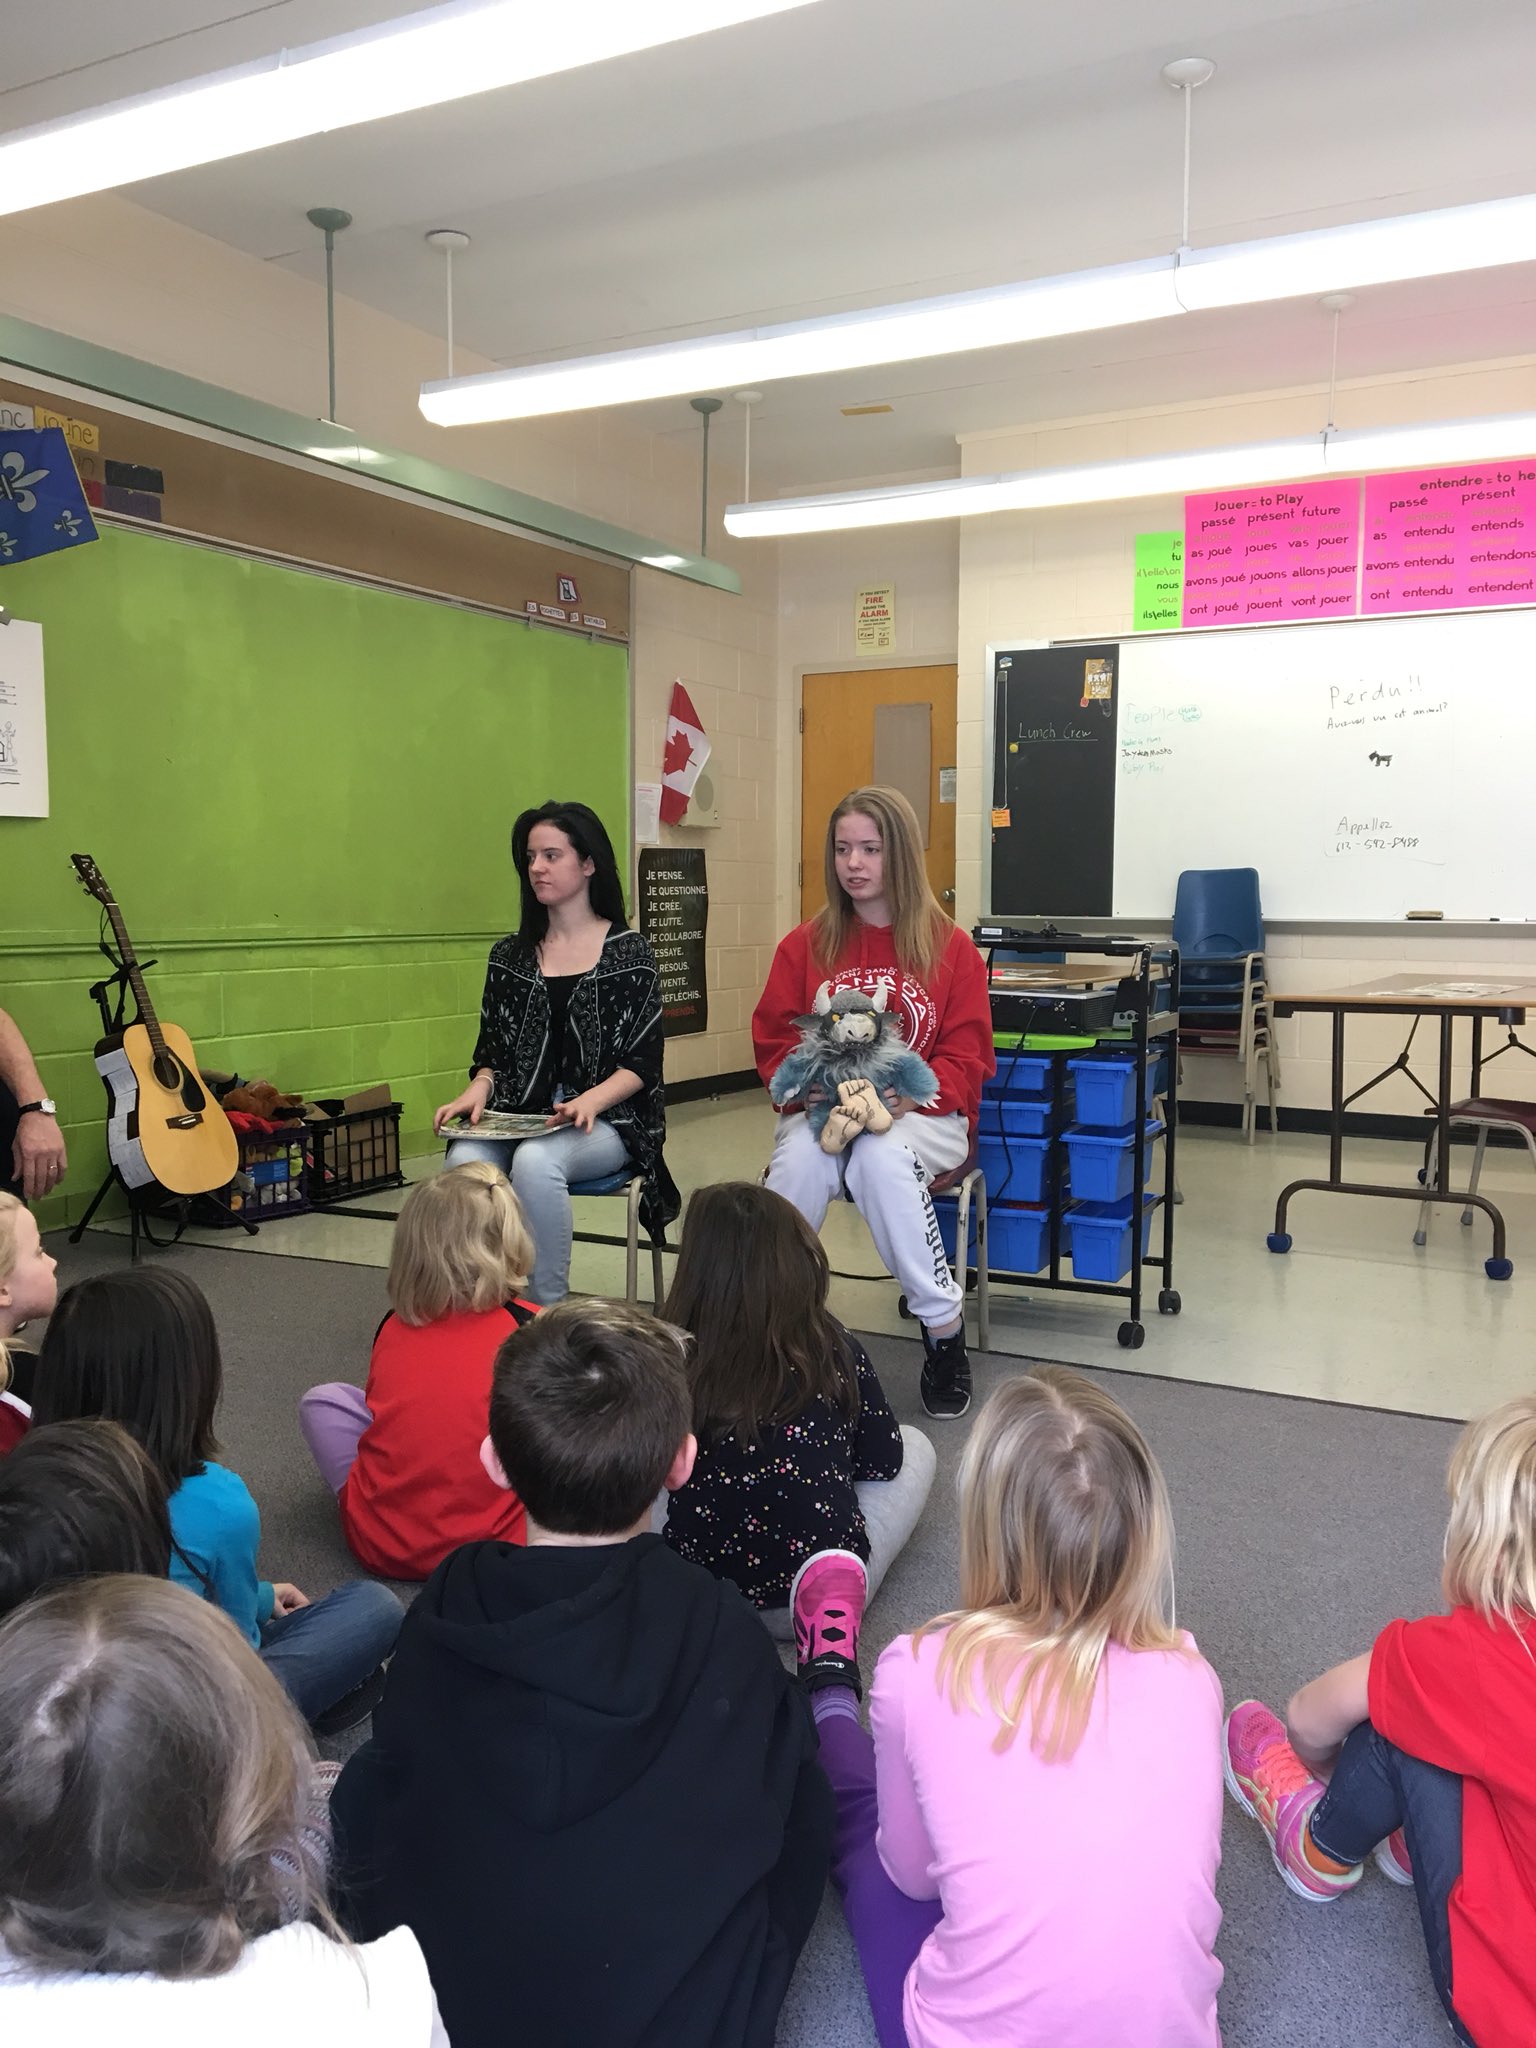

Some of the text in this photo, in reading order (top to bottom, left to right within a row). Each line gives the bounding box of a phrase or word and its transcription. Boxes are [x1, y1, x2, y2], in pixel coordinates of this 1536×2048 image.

[1419, 475, 1483, 491] entendre
[1497, 471, 1512, 483] to
[1260, 496, 1273, 507] to
[1276, 493, 1304, 507] Play
[1389, 486, 1516, 512] passé présent
[1201, 505, 1341, 532] passé présent future
[1373, 517, 1525, 541] as entendu entends
[1173, 539, 1183, 550] je
[1191, 535, 1349, 560] as joué joues vas jouer
[1171, 552, 1182, 561] tu
[1365, 559, 1401, 571] avons
[1403, 554, 1455, 568] entendu
[1470, 548, 1536, 563] entendons
[1185, 576, 1218, 587] avons
[1221, 573, 1246, 587] joué
[1250, 570, 1287, 585] jouons
[1292, 565, 1326, 578] allons
[1326, 564, 1358, 579] jouer
[1156, 581, 1180, 590] nous
[1370, 589, 1391, 600] ont
[1402, 584, 1454, 599] entendu
[1468, 579, 1534, 594] entendent
[866, 596, 883, 604] FIRE
[1189, 604, 1209, 615] ont
[1214, 602, 1240, 616] joué
[1246, 597, 1283, 614] jouent
[1291, 595, 1317, 607] vont
[1319, 594, 1352, 608] jouer
[861, 610, 888, 618] ALARM
[1018, 721, 1092, 740] Lunch Crew
[657, 870, 685, 880] PENSE.
[659, 899, 682, 911] CRÉE.
[658, 916, 683, 927] LUTTE.
[658, 930, 704, 942] COLLABORE.
